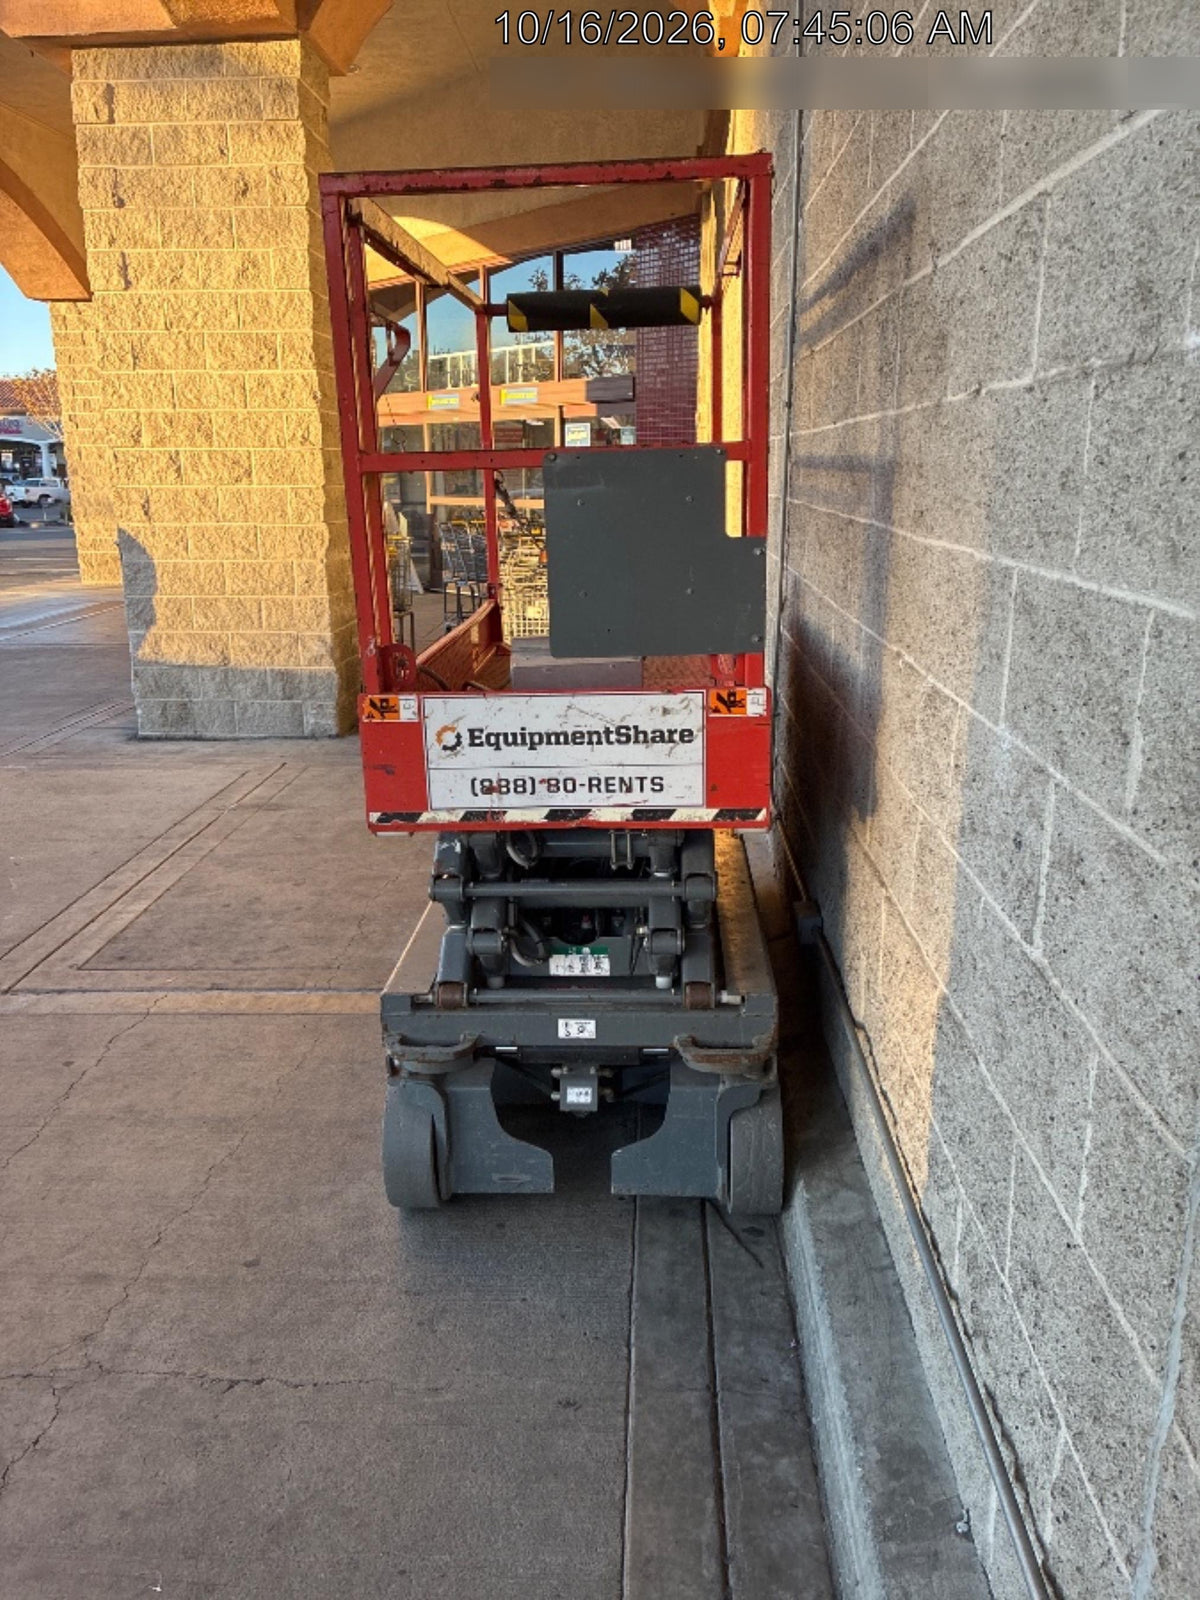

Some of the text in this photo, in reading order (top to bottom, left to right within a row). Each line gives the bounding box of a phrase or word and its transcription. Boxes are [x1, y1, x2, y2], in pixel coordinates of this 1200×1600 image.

[468, 725, 694, 751] EquipmentShare
[470, 776, 664, 797] (888) 80-RENTS
